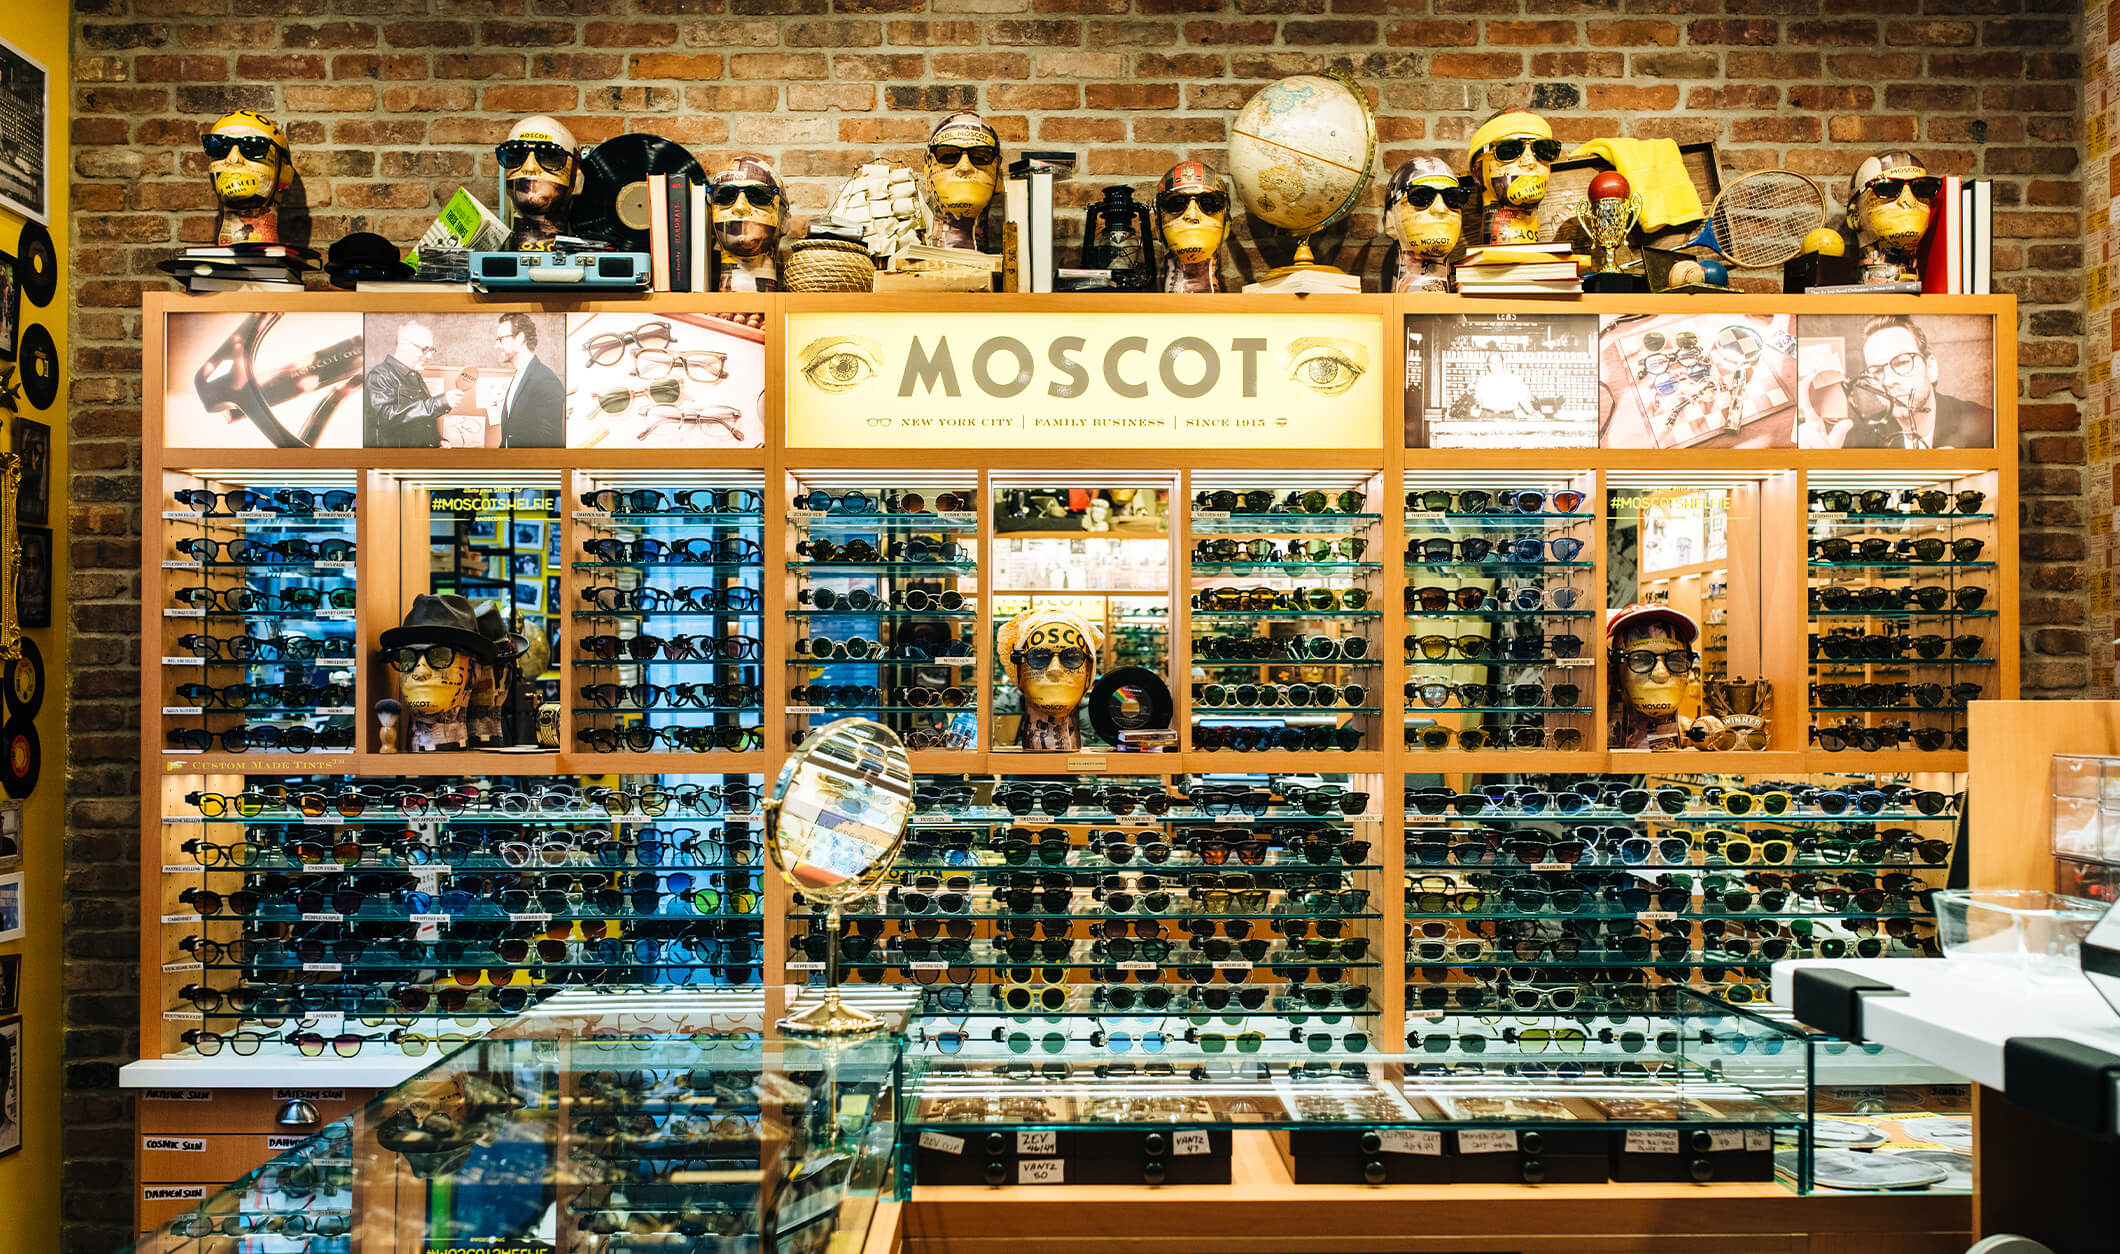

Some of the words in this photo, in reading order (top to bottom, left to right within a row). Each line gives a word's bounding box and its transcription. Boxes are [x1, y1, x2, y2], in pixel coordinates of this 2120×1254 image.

[957, 131, 989, 141] MOSCOT
[1889, 232, 1920, 240] MOSCOT
[1420, 238, 1450, 246] MOSCOT
[897, 335, 1268, 400] MOSCOT
[901, 418, 934, 427] NEW
[938, 418, 977, 427] YORK
[981, 418, 1014, 427] CITY
[1034, 418, 1089, 428] FAMILY
[1093, 418, 1166, 427] BUSINESS
[1186, 418, 1230, 427] SINCE
[1235, 418, 1267, 427] 1915
[431, 498, 554, 511] #MOSCOTSHELFIE
[1610, 497, 1732, 510] #MOSCOTSHELFIE
[1723, 715, 1762, 727] WINNER
[187, 1090, 210, 1099] SUN
[322, 1090, 344, 1099] SUN
[1022, 1133, 1049, 1145] ZEV
[146, 1140, 180, 1150] COSMIC
[182, 1141, 203, 1151] SUN
[182, 1188, 203, 1199] SUN
